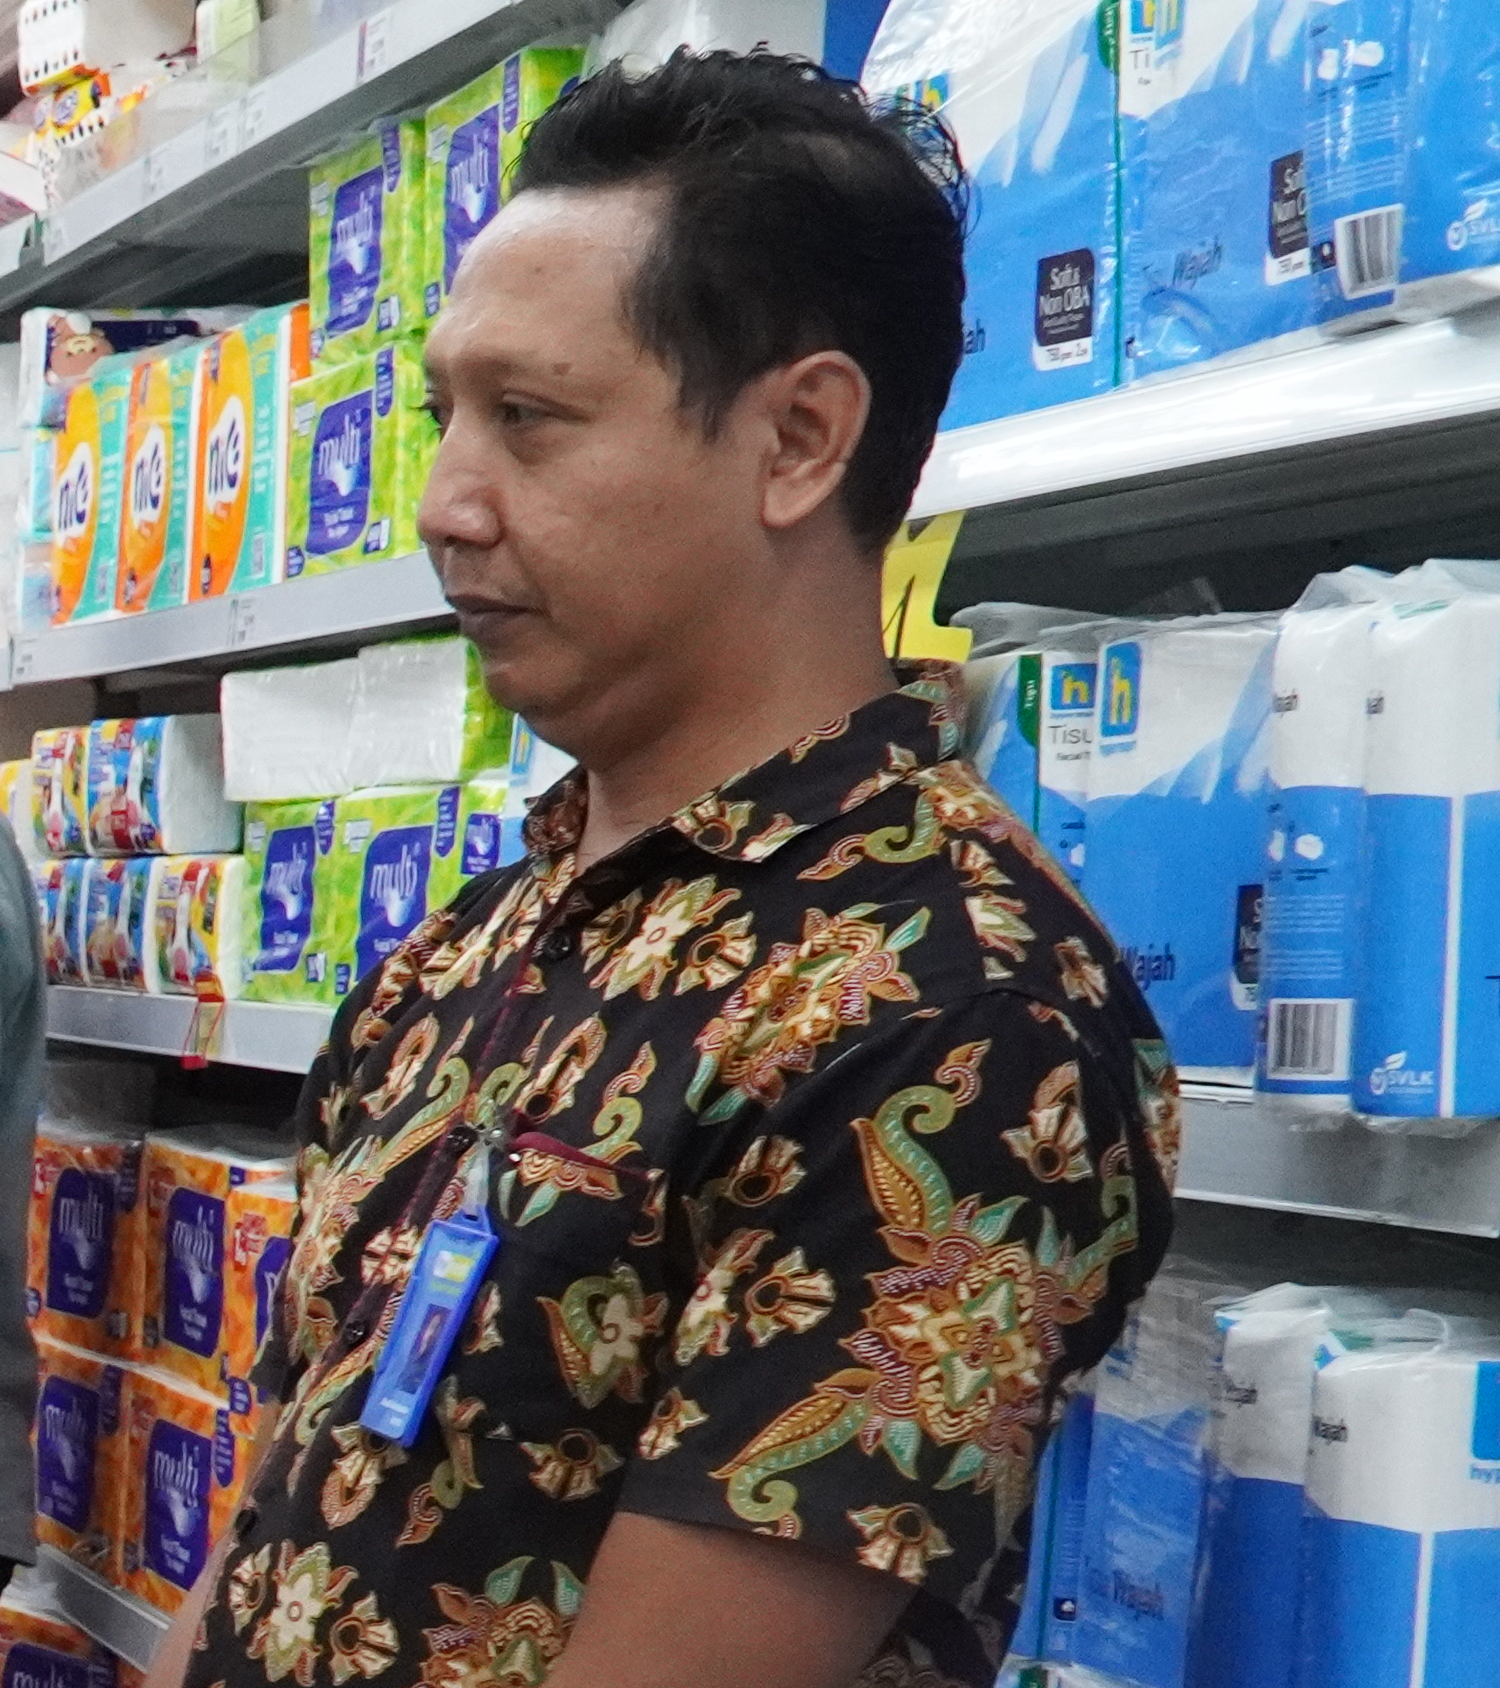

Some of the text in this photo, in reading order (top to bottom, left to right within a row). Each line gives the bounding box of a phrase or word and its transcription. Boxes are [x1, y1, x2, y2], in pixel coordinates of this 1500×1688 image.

[451, 126, 489, 202] multi
[336, 187, 376, 246] multi
[319, 410, 362, 475] multi
[370, 841, 421, 899] multi
[1388, 1069, 1434, 1088] SVLK
[172, 1205, 217, 1267] multi
[153, 1440, 200, 1494] multi
